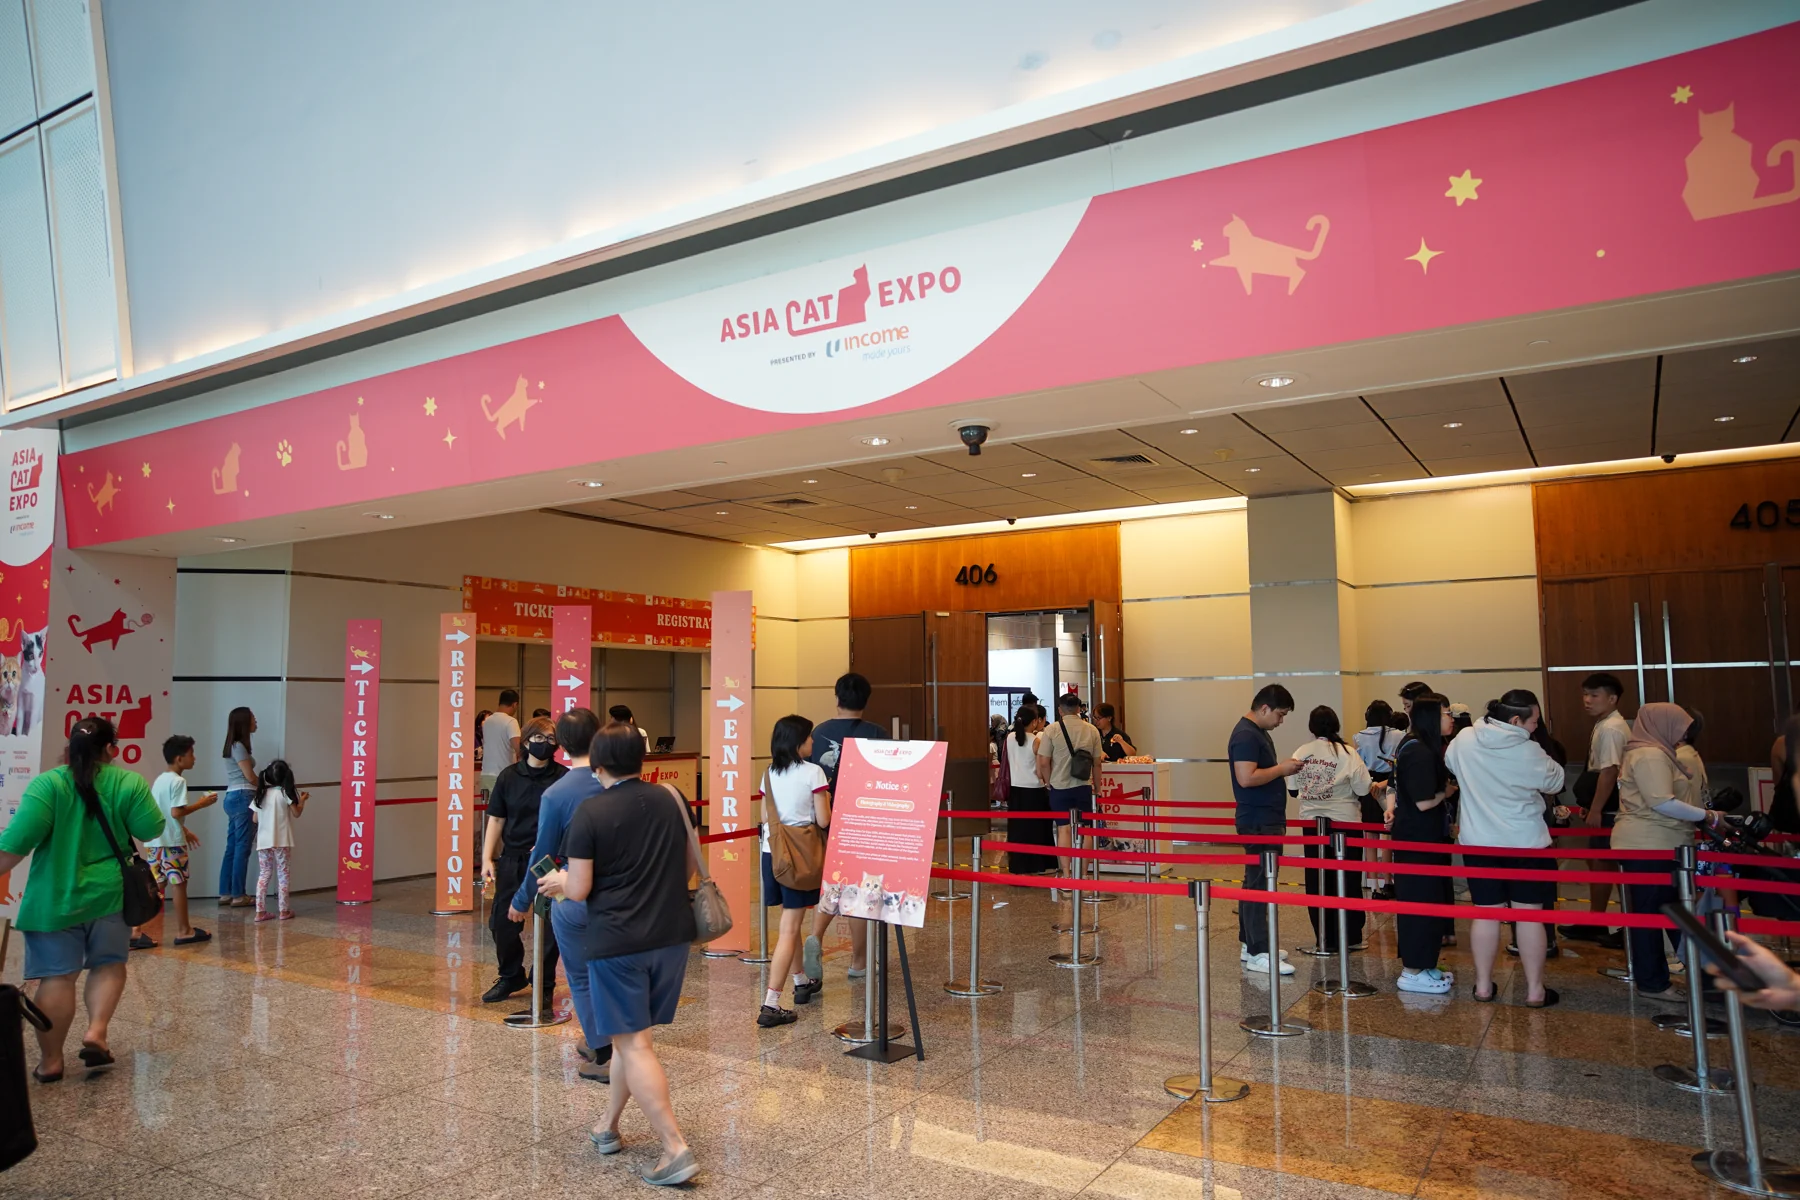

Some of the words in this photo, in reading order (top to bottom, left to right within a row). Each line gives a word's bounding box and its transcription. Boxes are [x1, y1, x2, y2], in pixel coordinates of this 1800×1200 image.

[720, 307, 780, 342] ASIA
[785, 294, 834, 337] CAT
[878, 266, 962, 308] EXPO
[770, 353, 807, 366] PRESENTED
[808, 351, 816, 359] BY
[844, 325, 909, 351] income
[862, 348, 886, 361] made
[887, 345, 911, 359] yours
[12, 447, 36, 466] ASIA
[10, 469, 29, 492] CAT
[9, 492, 38, 511] EXPO
[1730, 499, 1800, 529] 405
[955, 563, 998, 585] 406
[513, 602, 554, 618] TICKE
[657, 613, 712, 629] REGISTRA
[66, 684, 133, 704] ASIA
[990, 697, 1008, 707] them
[64, 710, 117, 739] CT
[349, 679, 369, 859] TICKETING
[447, 650, 465, 894] REGISTRATION
[660, 771, 679, 780] EXPO
[721, 719, 739, 843] ENTRY
[875, 780, 899, 791] Notice
